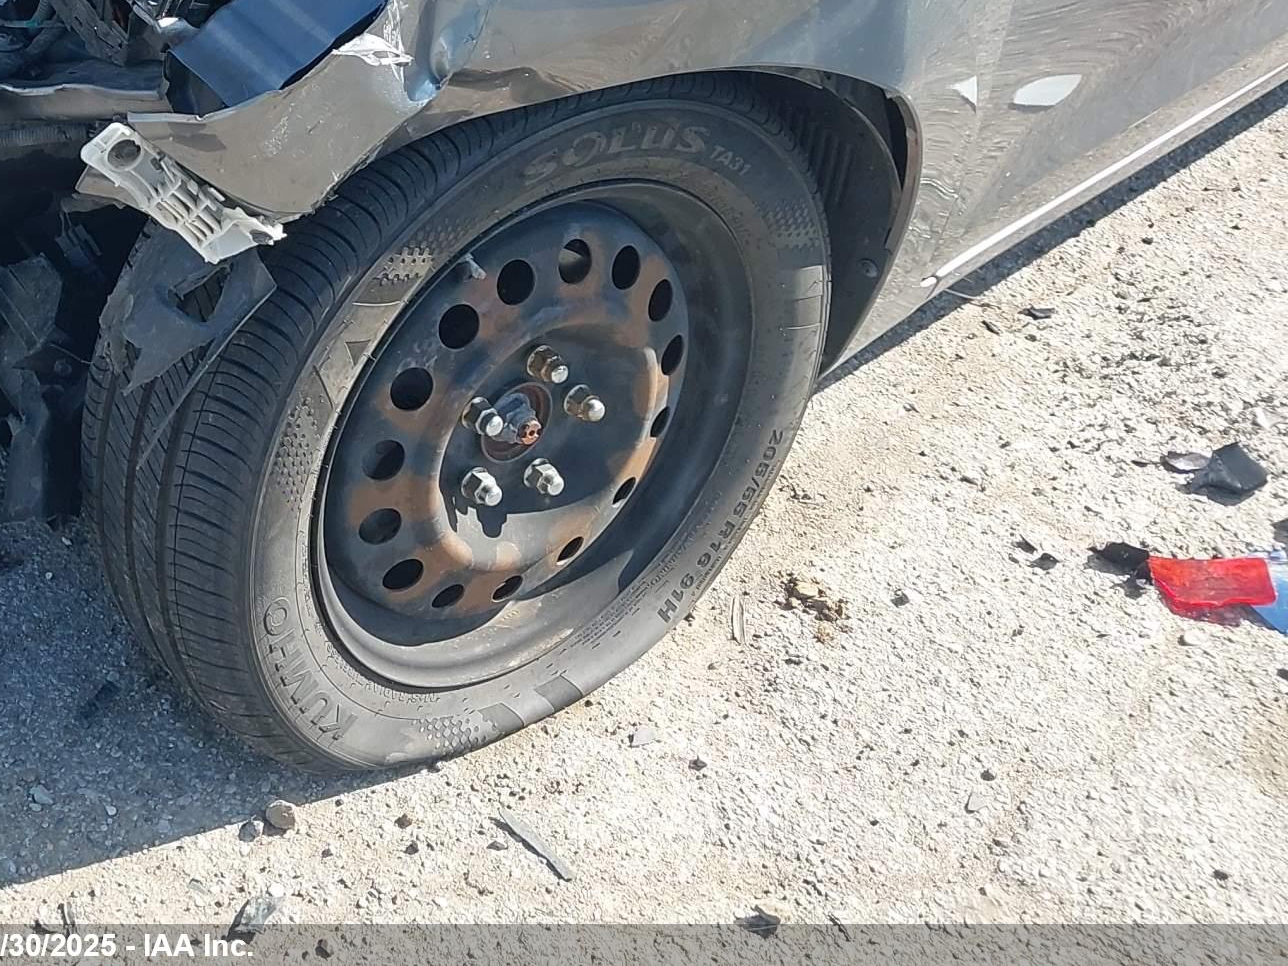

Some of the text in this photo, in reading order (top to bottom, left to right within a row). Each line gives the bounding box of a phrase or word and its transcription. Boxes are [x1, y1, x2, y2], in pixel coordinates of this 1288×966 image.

[524, 122, 752, 185] SOLUS TA31
[733, 429, 784, 518] 205/55
[697, 520, 736, 568] R16
[657, 572, 695, 623] 91H
[263, 596, 359, 741] KUMHO
